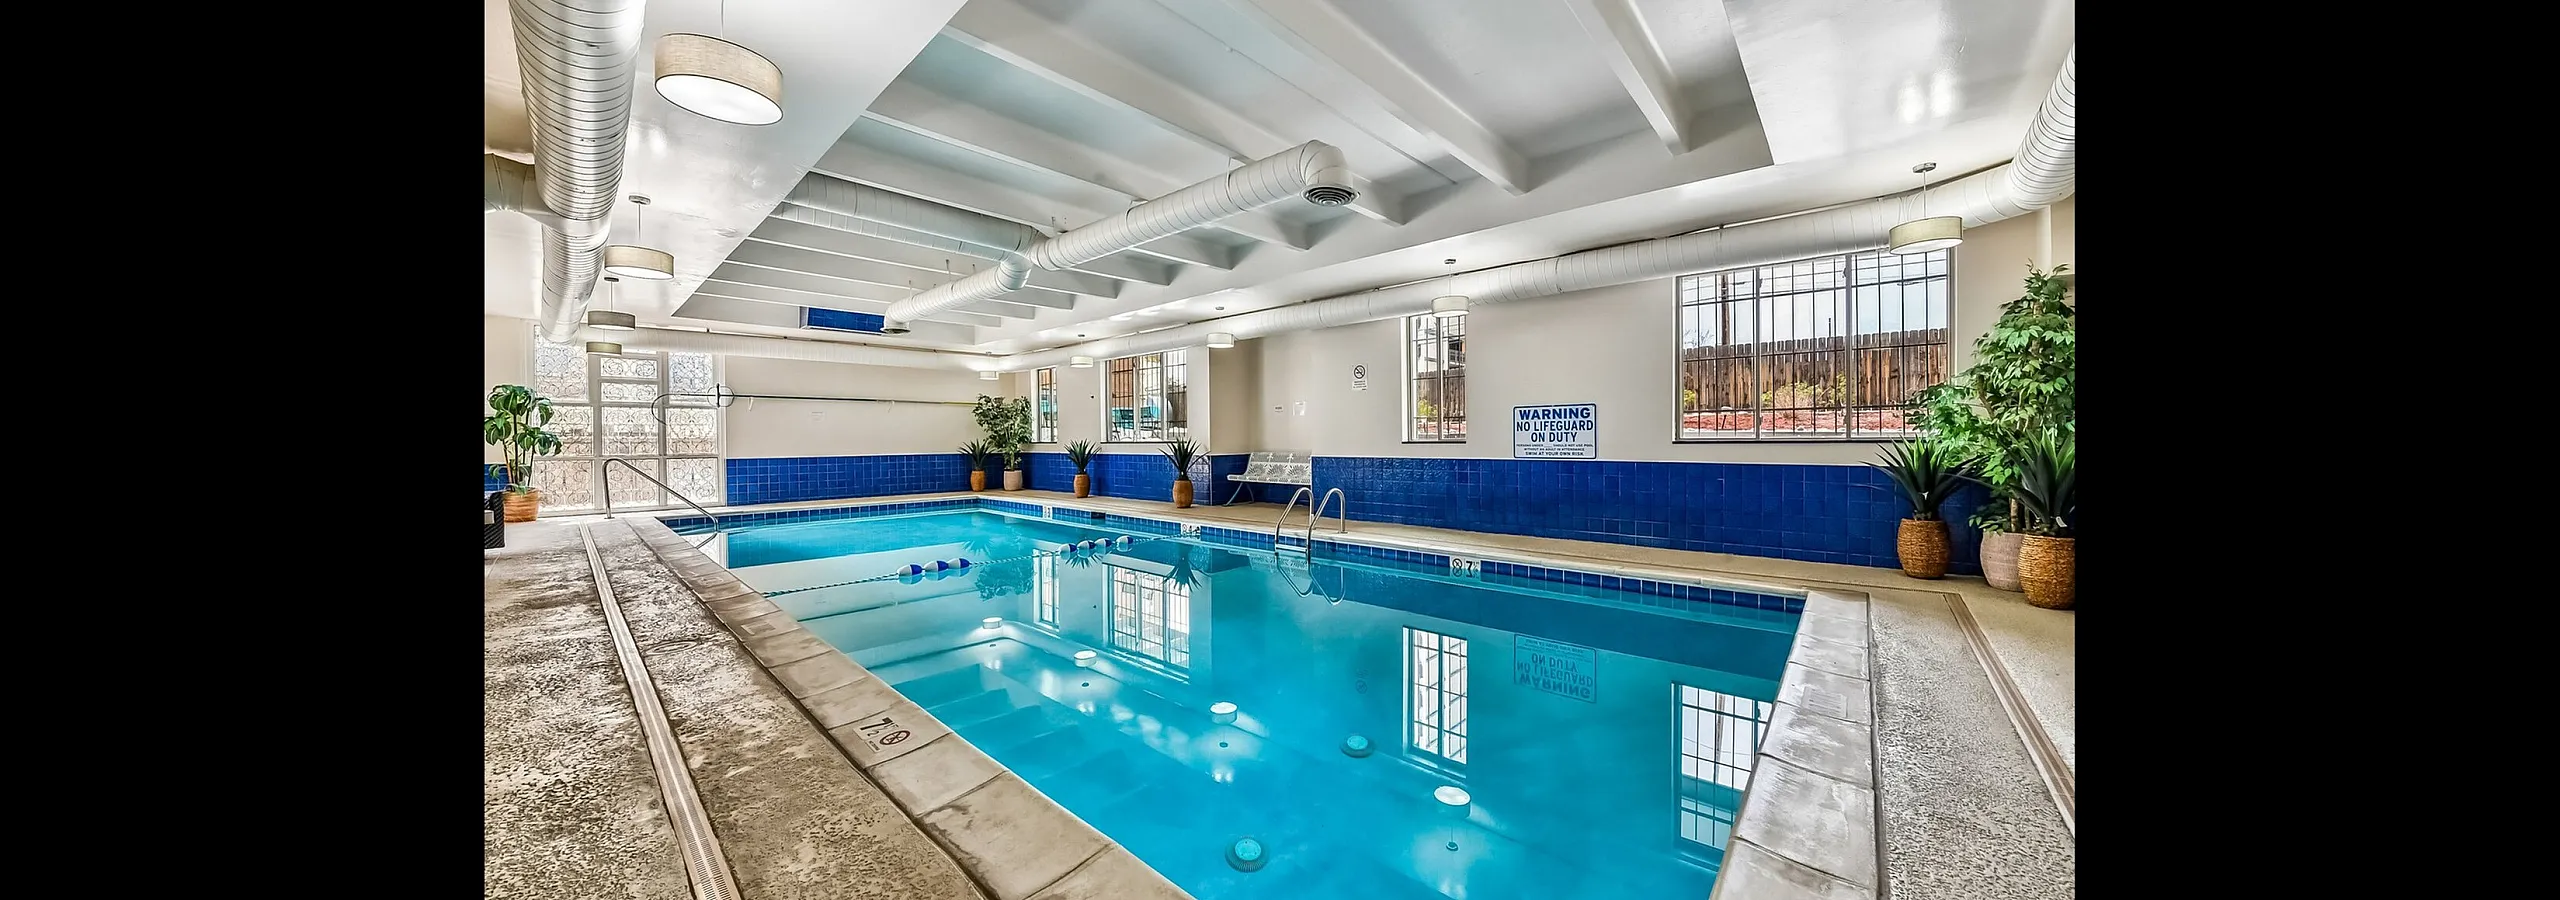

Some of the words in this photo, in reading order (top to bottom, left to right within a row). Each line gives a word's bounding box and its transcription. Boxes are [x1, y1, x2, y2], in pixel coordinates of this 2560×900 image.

[1519, 408, 1591, 420] WARNING
[1516, 421, 1530, 431] NO
[1534, 420, 1593, 431] LIFEGUARD
[1531, 432, 1545, 442] ON
[1549, 432, 1577, 442] DUTY
